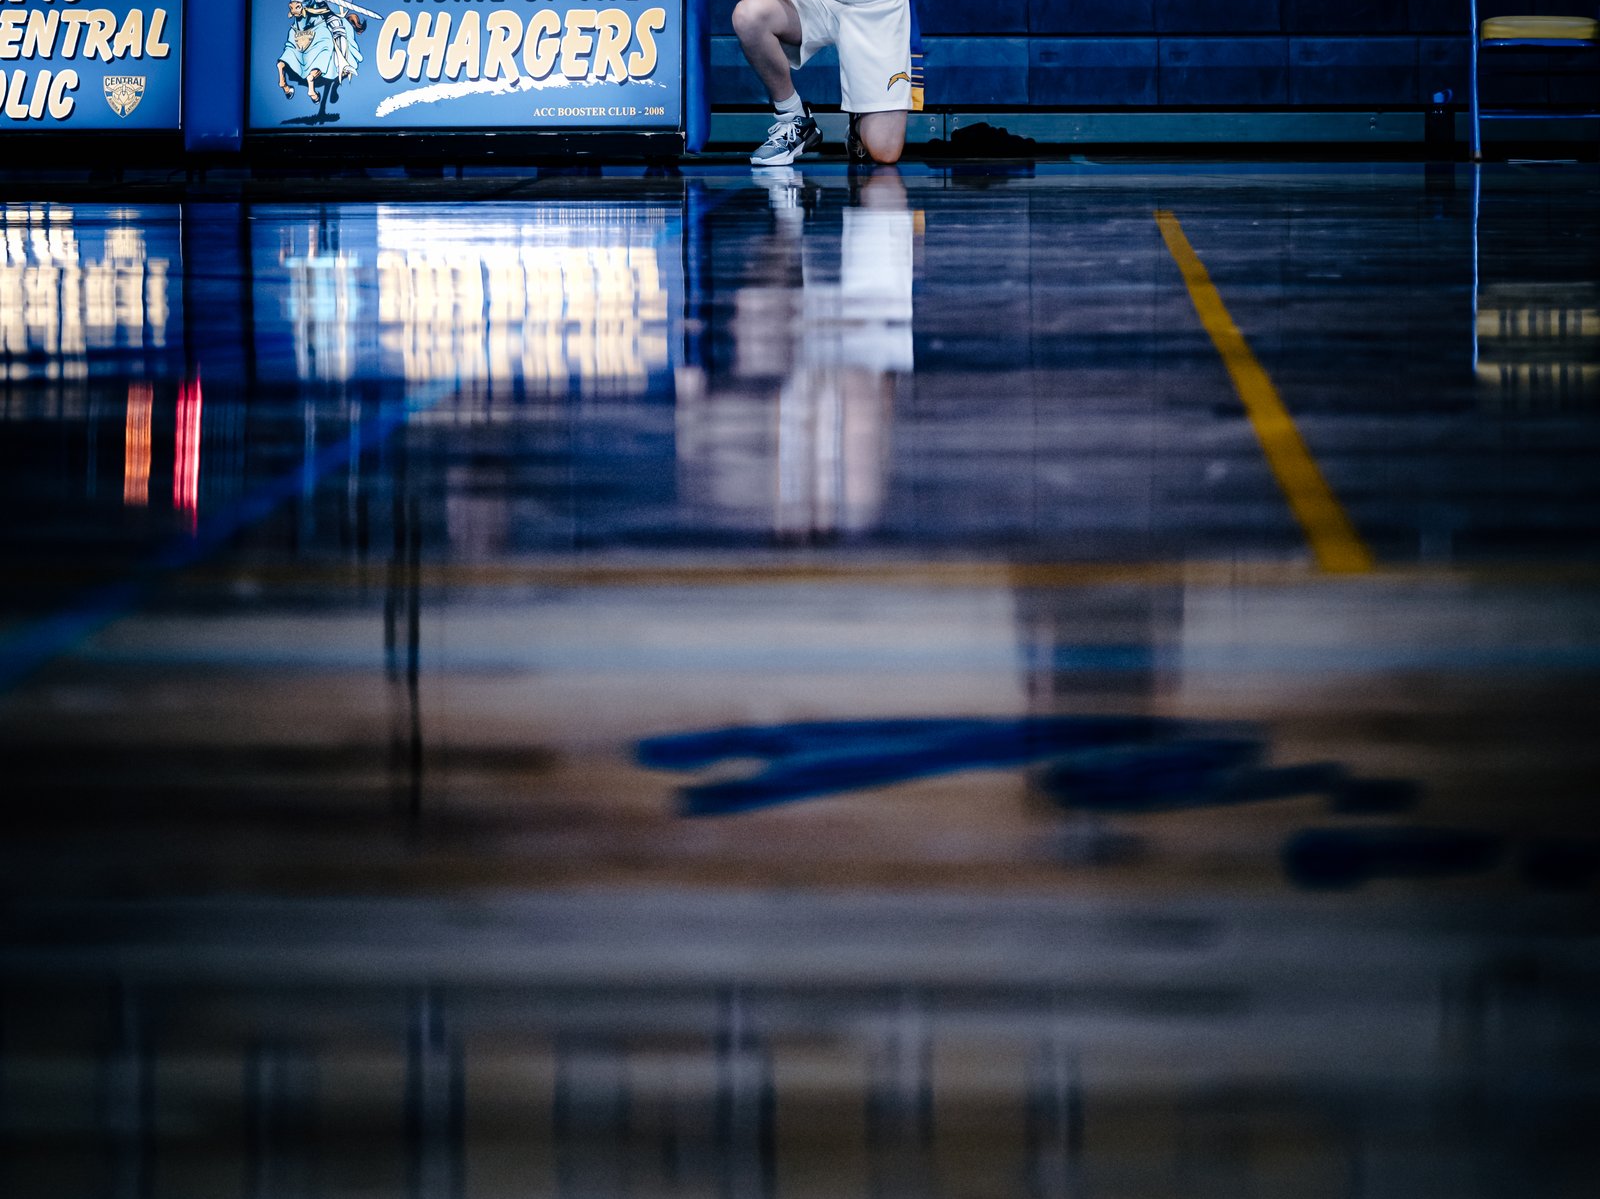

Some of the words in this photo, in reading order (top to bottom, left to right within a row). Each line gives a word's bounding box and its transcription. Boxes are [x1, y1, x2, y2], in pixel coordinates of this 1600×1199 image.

[376, 7, 666, 84] CHARGERS
[0, 68, 79, 119] LIC
[104, 76, 144, 88] CENTRAL
[533, 107, 556, 117] ACC
[557, 107, 606, 117] BOOSTER
[607, 106, 637, 116] CLUB
[644, 106, 665, 116] 2008
